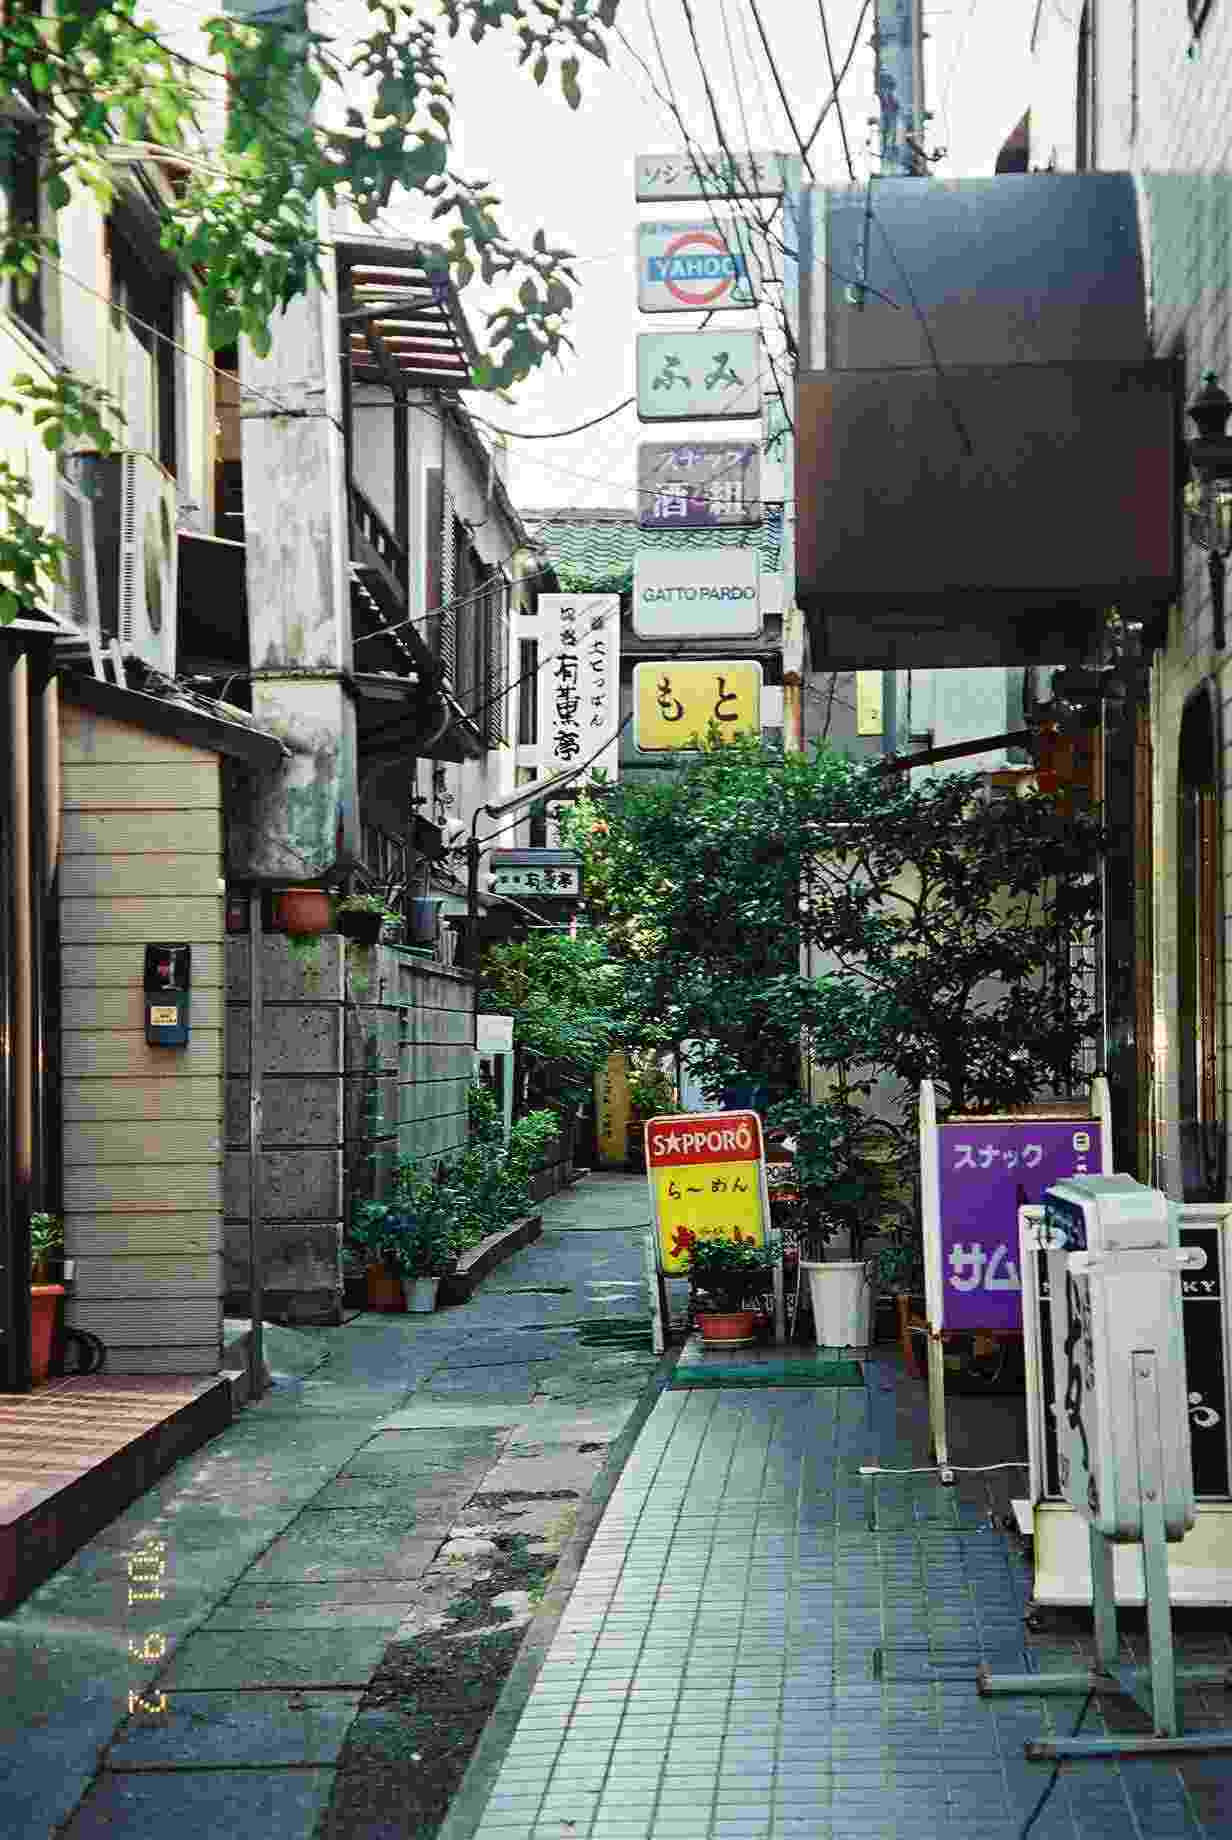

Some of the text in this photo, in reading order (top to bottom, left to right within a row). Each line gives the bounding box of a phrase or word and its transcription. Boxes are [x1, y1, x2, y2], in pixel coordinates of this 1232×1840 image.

[651, 351, 744, 391] ふみ
[656, 675, 739, 722] もと
[953, 1143, 1044, 1169] スナック
